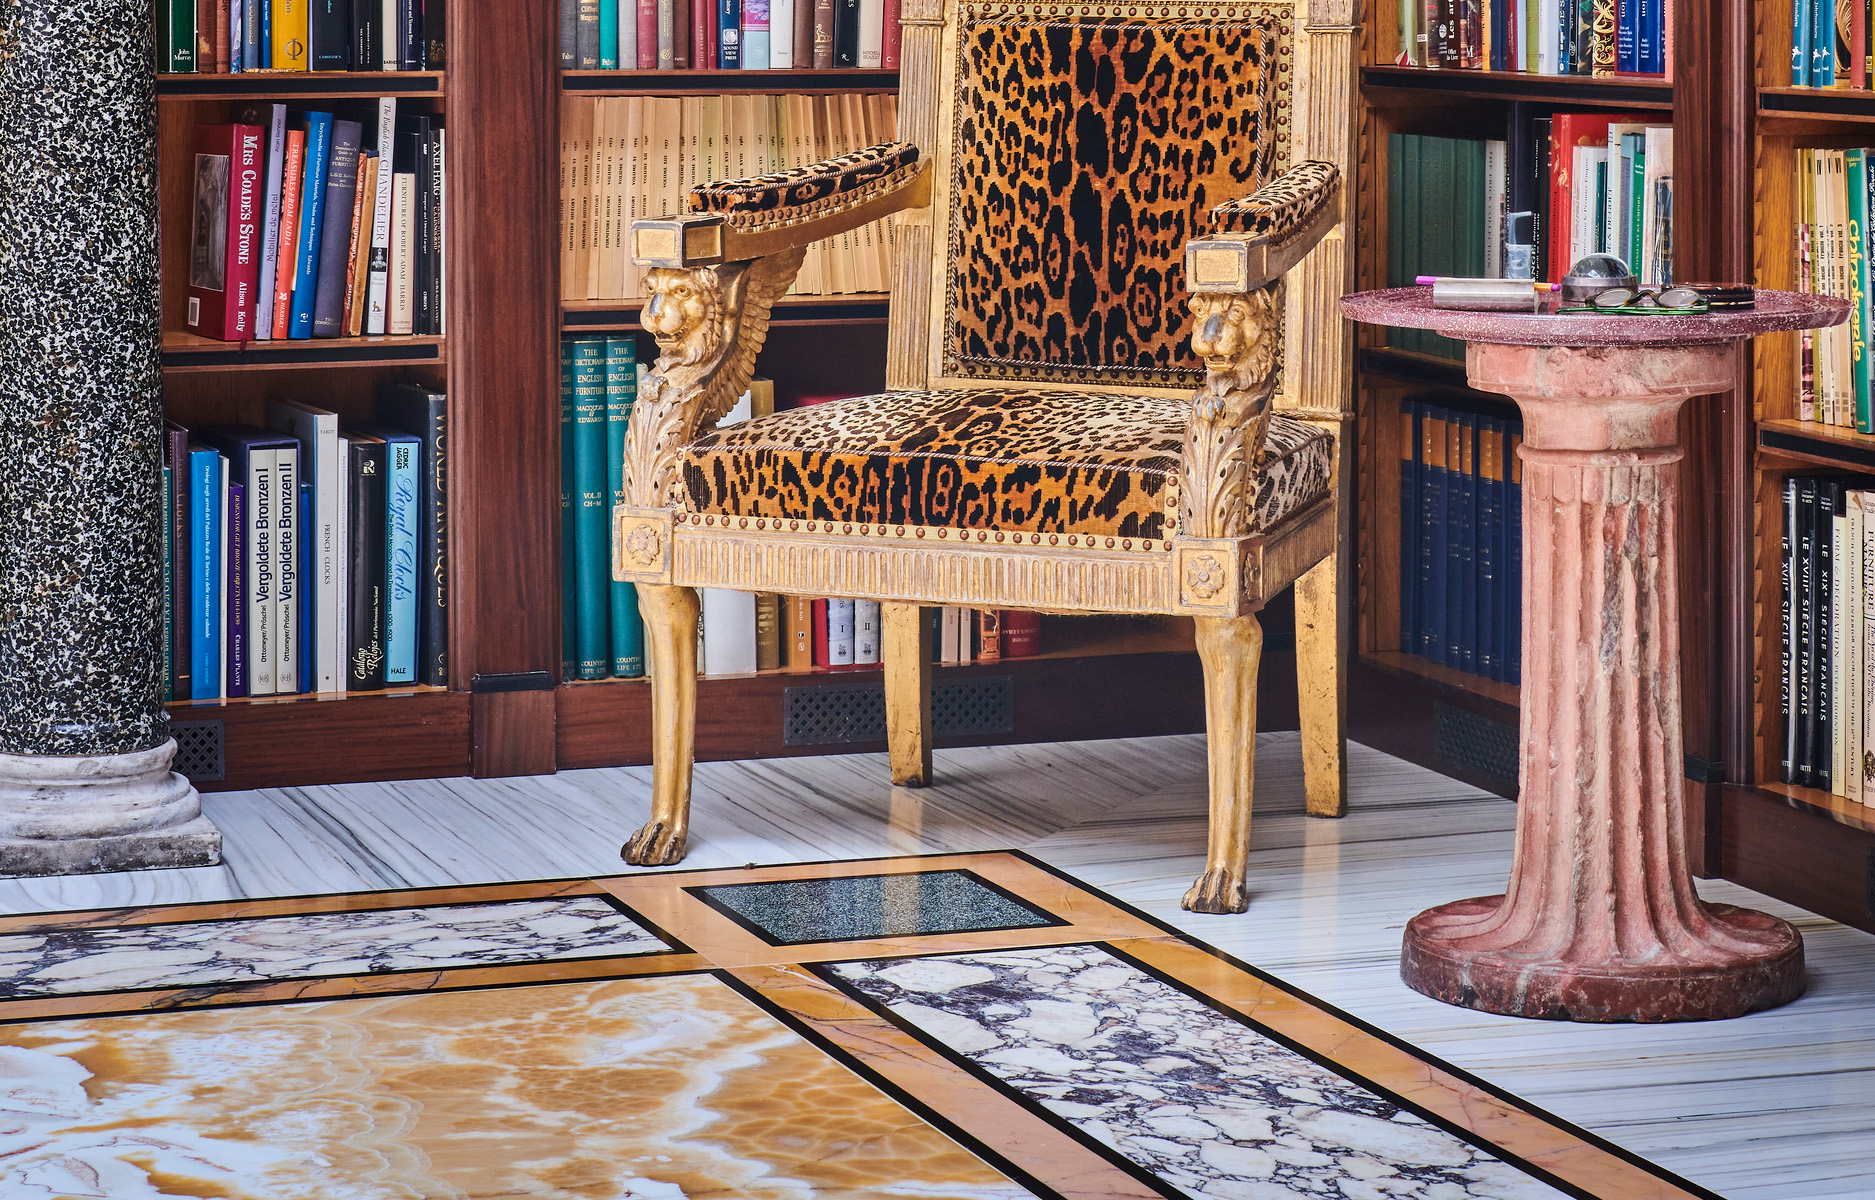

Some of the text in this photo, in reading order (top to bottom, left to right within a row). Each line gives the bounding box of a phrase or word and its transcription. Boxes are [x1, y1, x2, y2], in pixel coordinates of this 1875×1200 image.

[284, 144, 299, 246] TREASURES FROM INDIA
[376, 160, 389, 241] CHANDELIER
[400, 219, 407, 229] OF
[238, 281, 247, 306] Alison
[236, 311, 246, 332] Kelly
[256, 475, 269, 529] Bronzen
[389, 474, 413, 601] Royal Clocks
[1802, 537, 1809, 549] LE
[256, 532, 272, 603] Vergoldete
